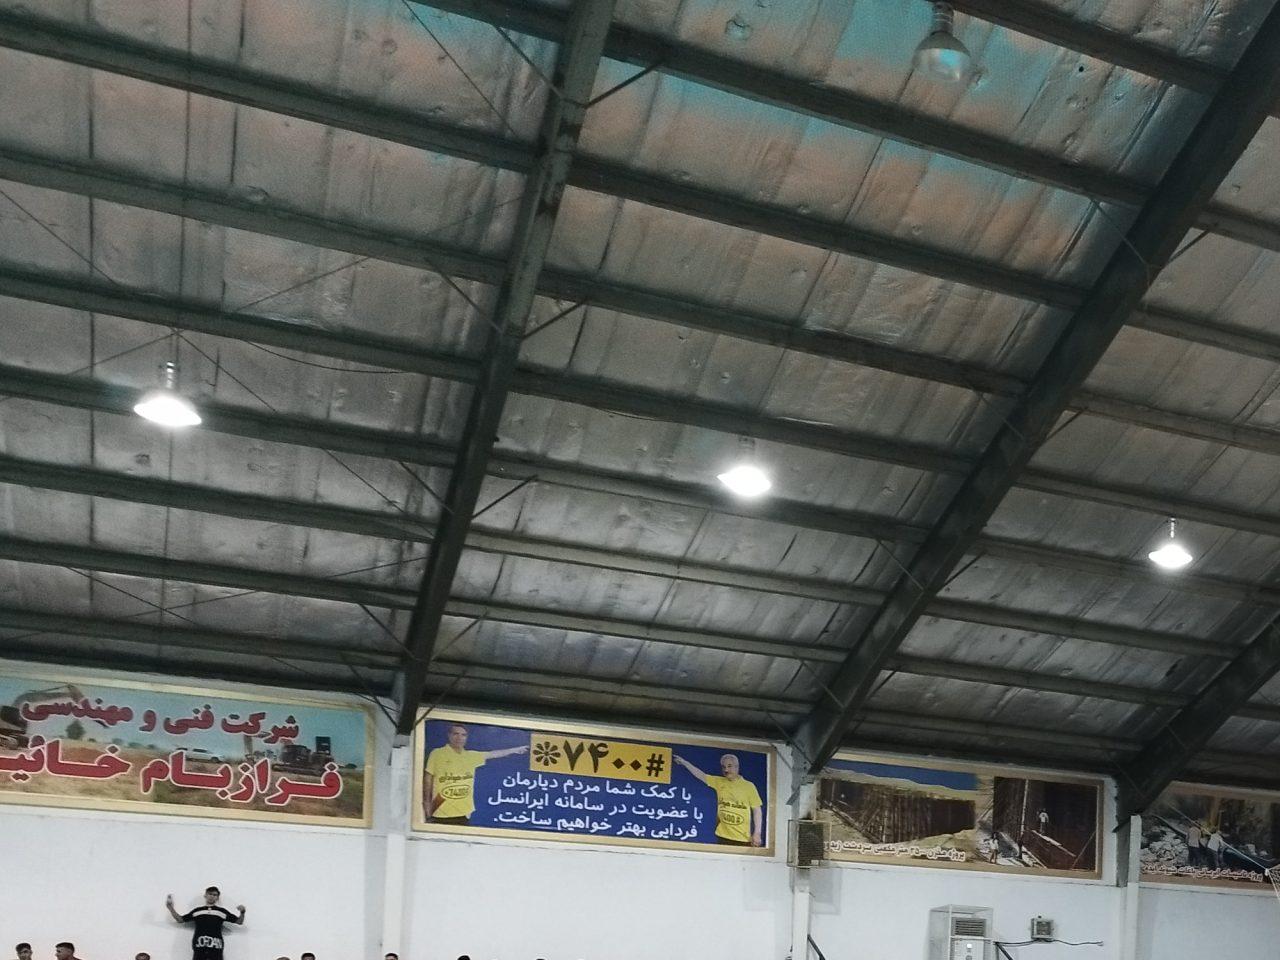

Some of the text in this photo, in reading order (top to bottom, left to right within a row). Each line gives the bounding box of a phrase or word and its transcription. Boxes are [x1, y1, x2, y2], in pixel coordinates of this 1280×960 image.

[21, 697, 300, 743] شرکت فنی و مهندسی
[0, 734, 132, 782] خائی
[502, 771, 692, 802] با کمک شما مردم دیارمان
[487, 788, 549, 809] ایرانسل
[554, 795, 605, 812] سامانه
[608, 801, 628, 817] در
[631, 804, 689, 821] عضویت
[556, 815, 613, 833] خواهیم
[616, 821, 647, 838] بهتر
[650, 822, 699, 840] فردایی
